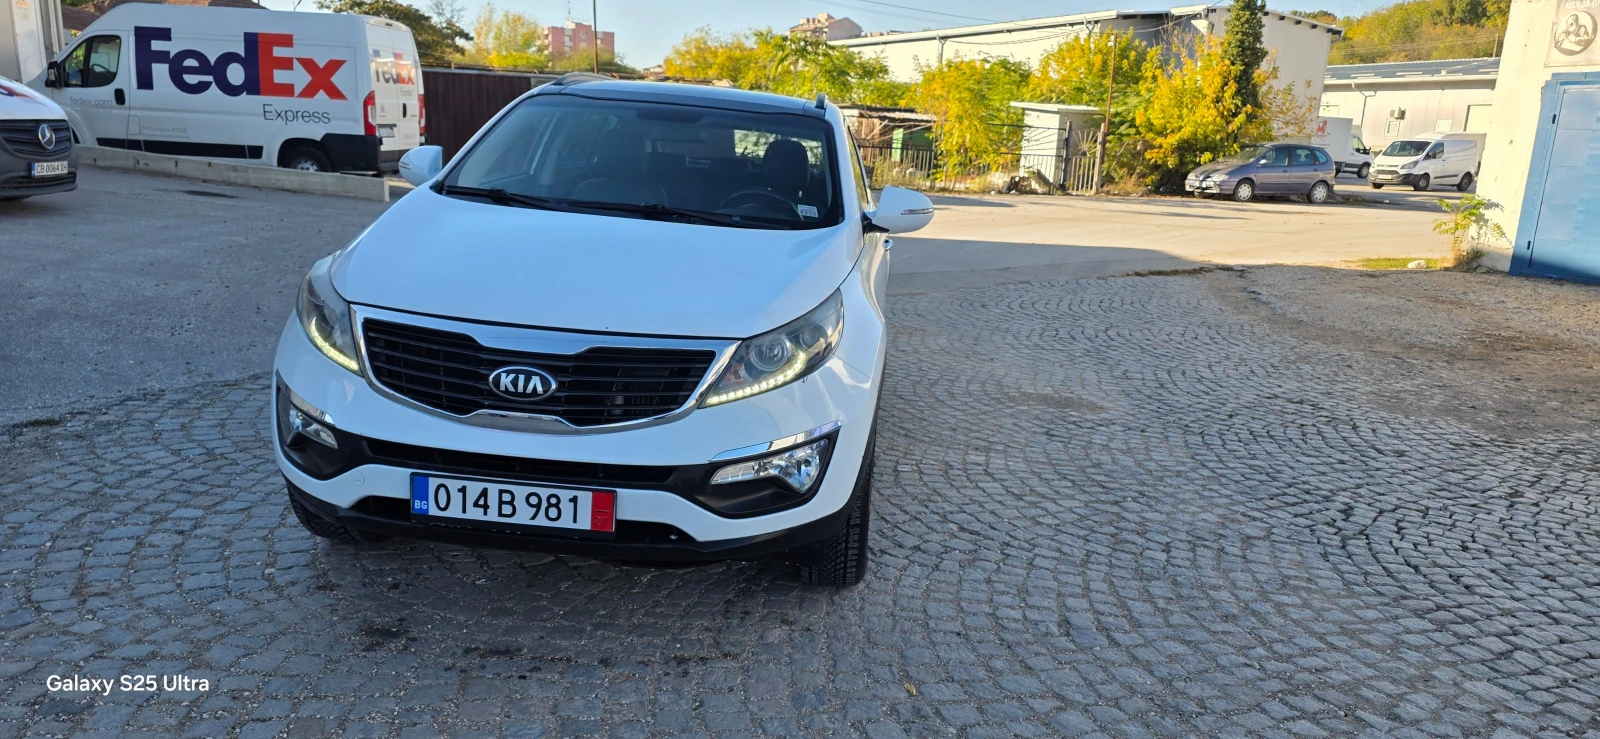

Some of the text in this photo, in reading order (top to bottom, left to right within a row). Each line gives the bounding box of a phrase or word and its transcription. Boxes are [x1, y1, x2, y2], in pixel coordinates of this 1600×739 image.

[134, 26, 348, 100] FedEx
[69, 96, 113, 106] fedex.com
[263, 104, 331, 125] Express
[36, 164, 45, 174] CB
[499, 373, 544, 395] KIA
[414, 500, 428, 510] BG
